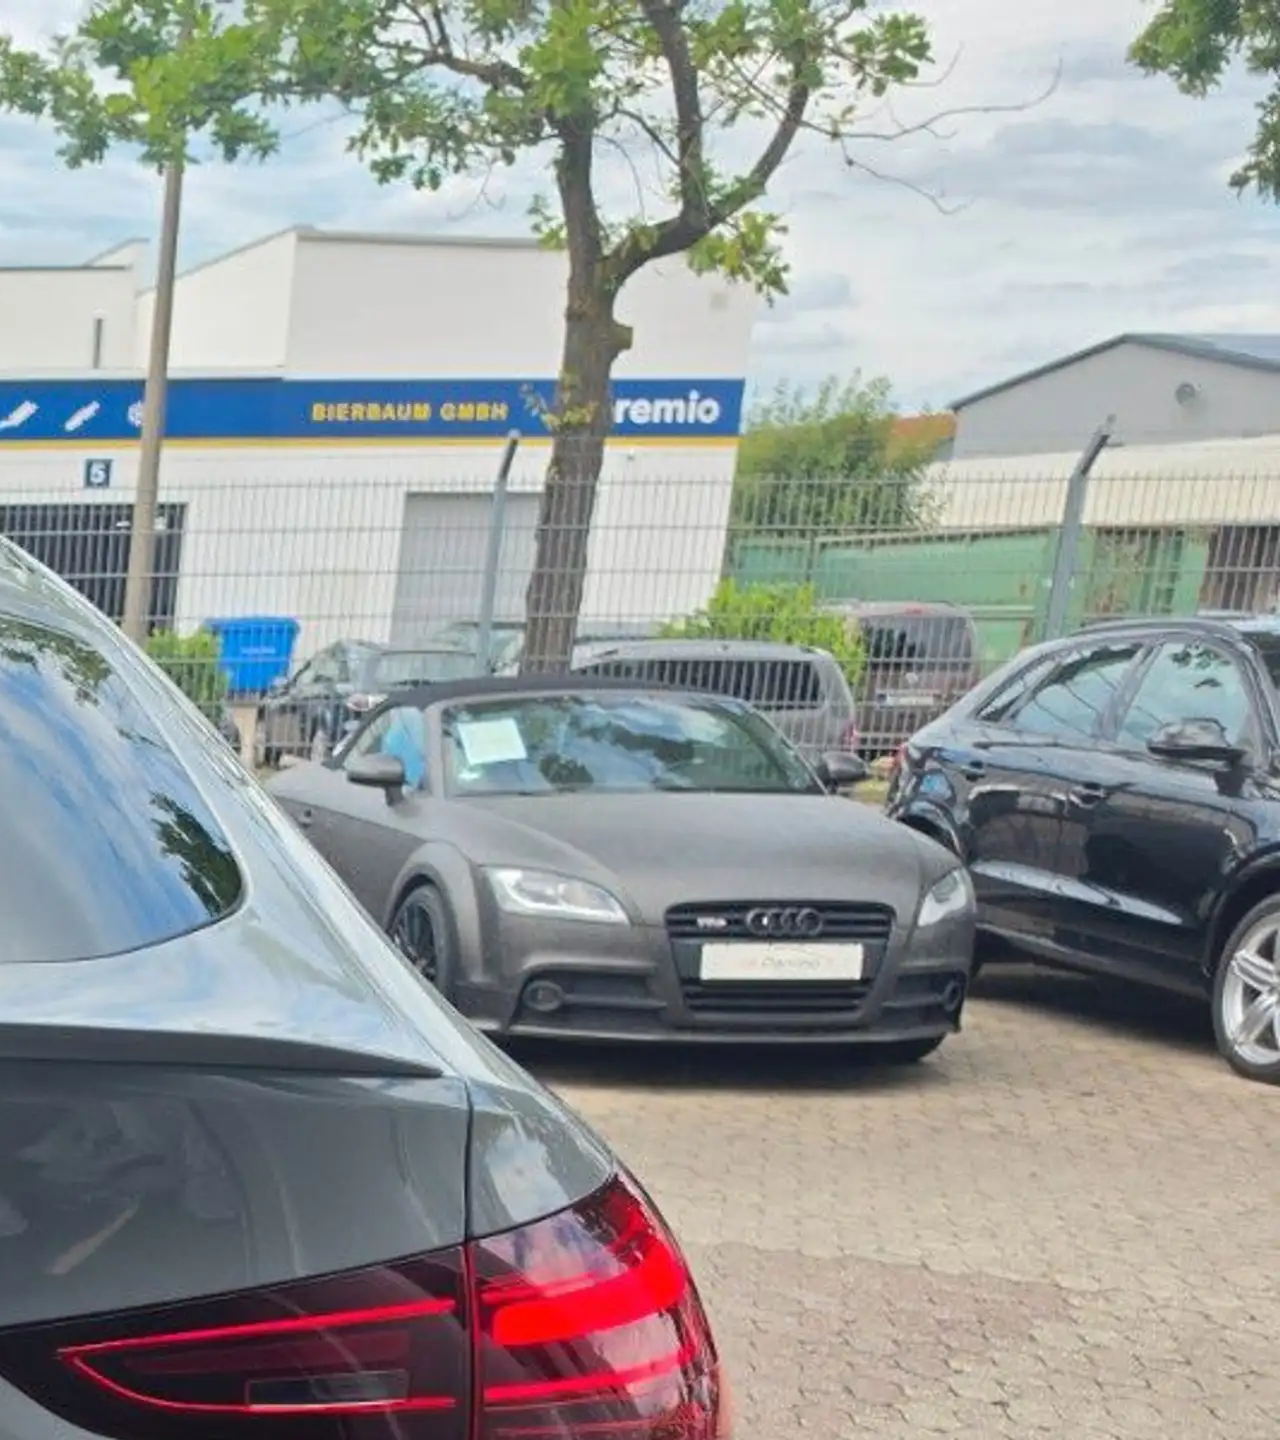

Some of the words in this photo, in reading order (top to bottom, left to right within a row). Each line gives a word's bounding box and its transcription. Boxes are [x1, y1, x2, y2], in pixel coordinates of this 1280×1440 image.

[312, 402, 432, 422] BIERBAUM
[440, 402, 509, 422] GMBH
[613, 389, 721, 424] remio
